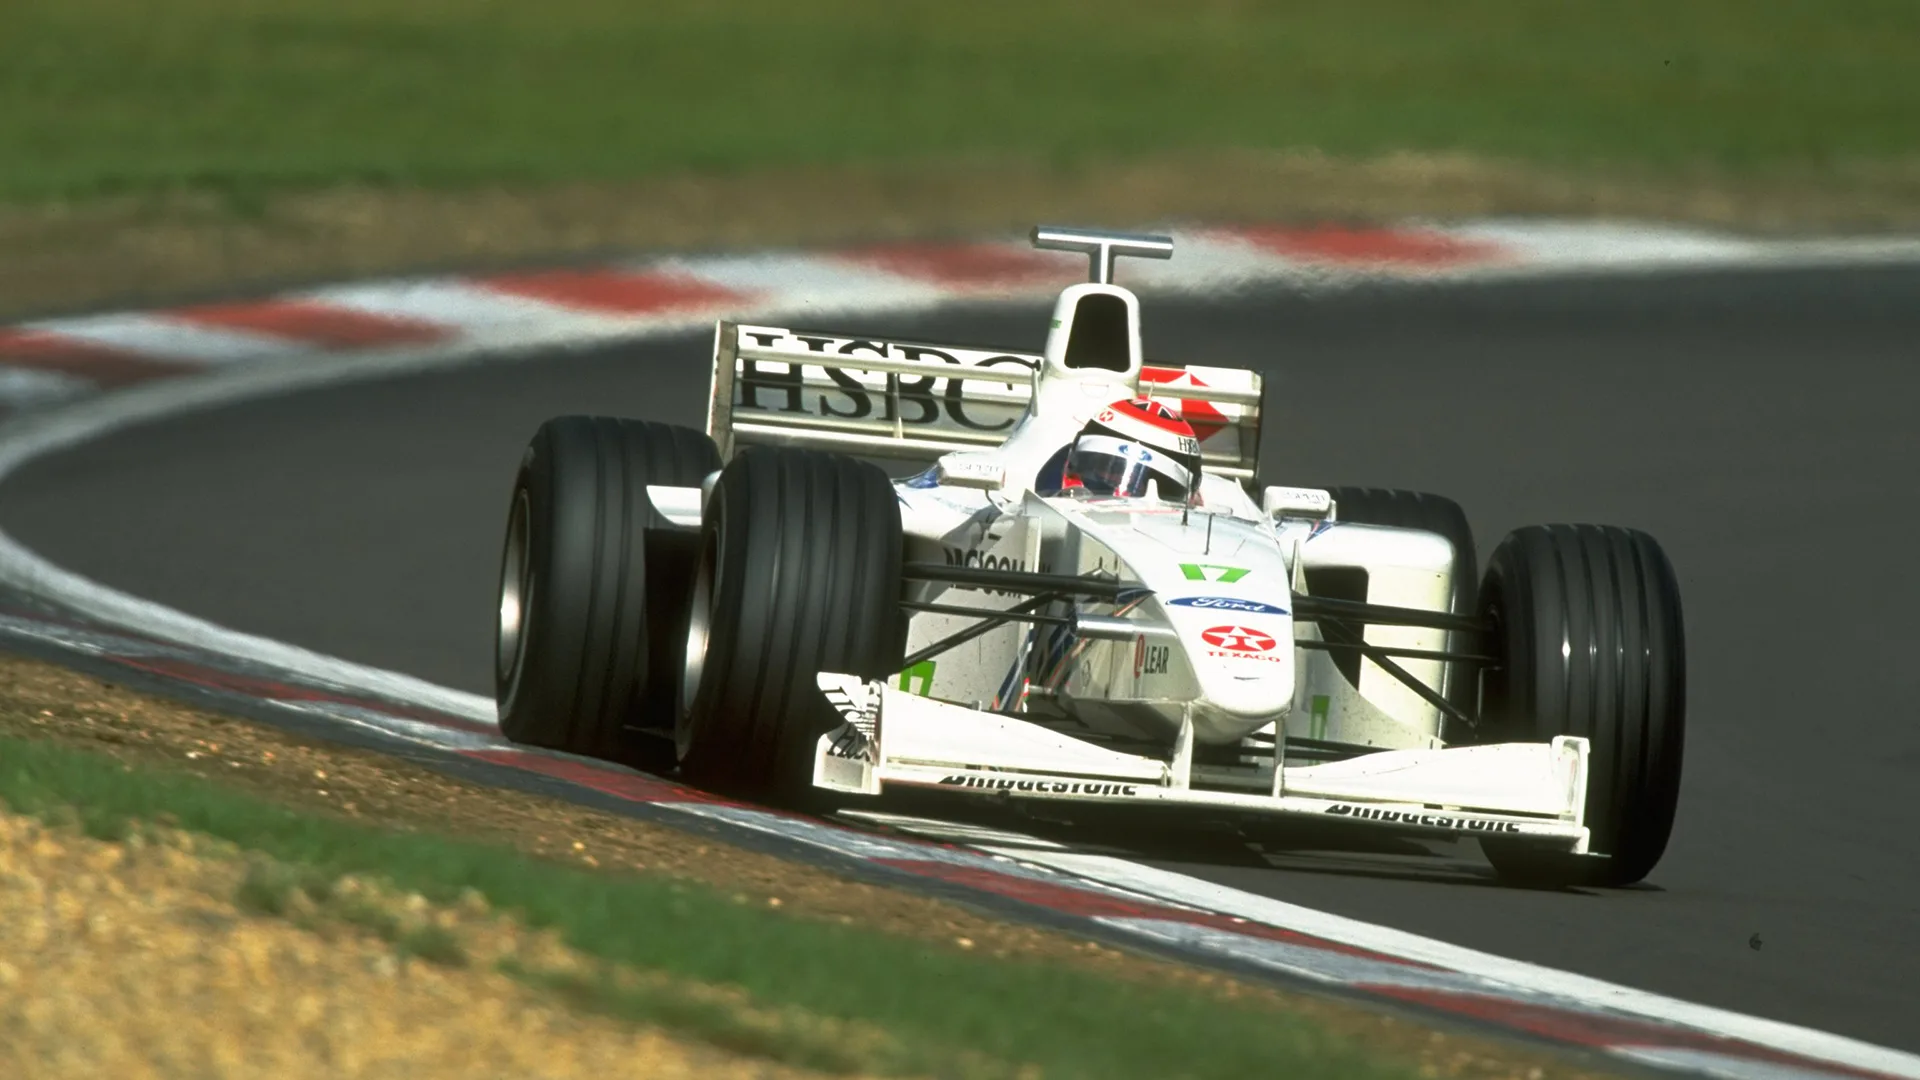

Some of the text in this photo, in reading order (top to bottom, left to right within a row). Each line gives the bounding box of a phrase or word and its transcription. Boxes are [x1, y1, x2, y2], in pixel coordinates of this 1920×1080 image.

[745, 332, 1042, 431] HSBC
[1178, 563, 1252, 583] 17
[1191, 598, 1266, 612] Ford
[1144, 646, 1169, 674] LEAR
[1207, 651, 1281, 662] TEXACO
